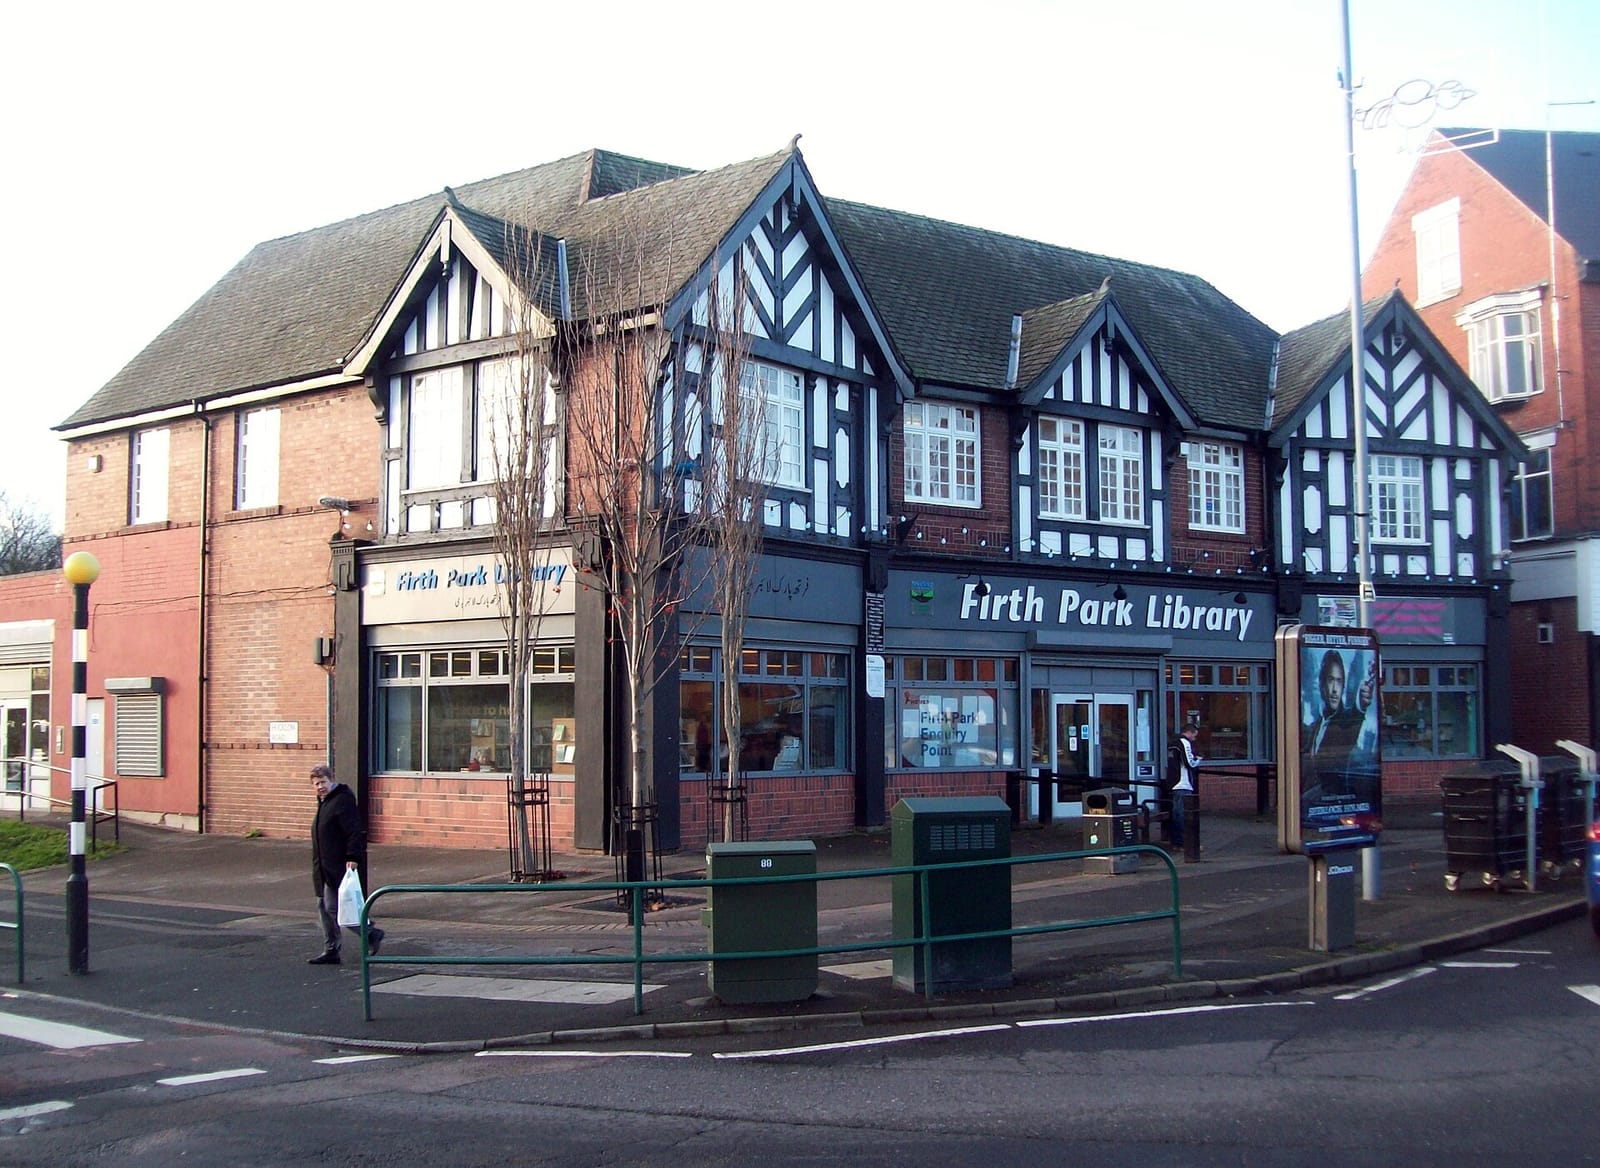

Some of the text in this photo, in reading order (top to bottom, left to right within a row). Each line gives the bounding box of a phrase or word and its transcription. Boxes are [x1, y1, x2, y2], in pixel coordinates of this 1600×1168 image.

[397, 564, 567, 591] Firth Park Lbary
[960, 583, 1254, 642] Firth Park Library
[951, 711, 977, 724] Park
[921, 727, 967, 743] Enquiry
[921, 743, 952, 756] Point
